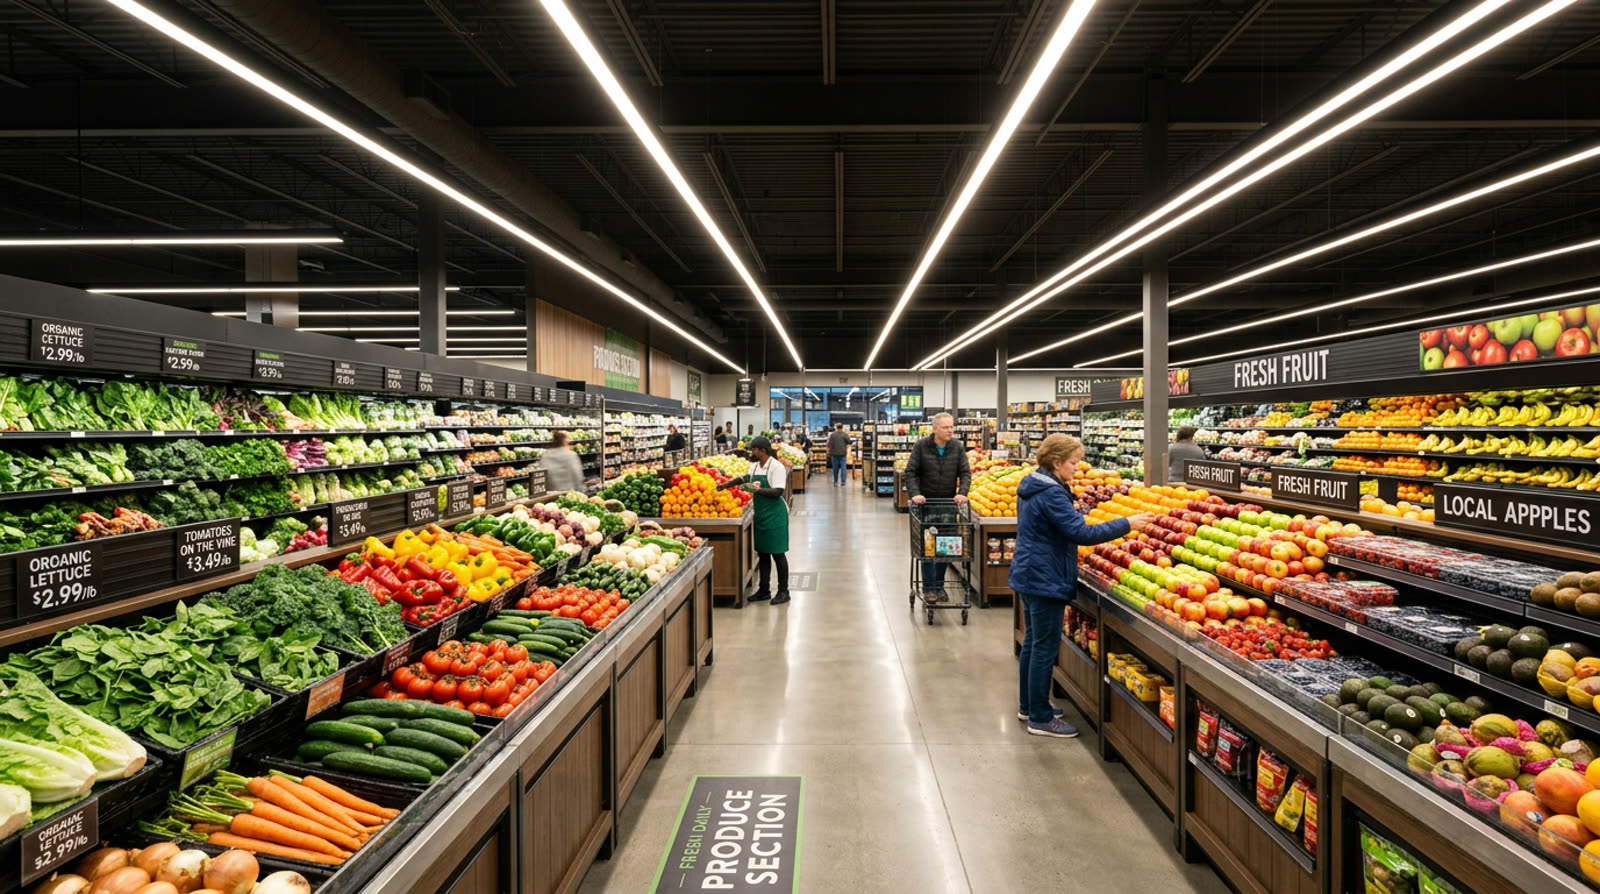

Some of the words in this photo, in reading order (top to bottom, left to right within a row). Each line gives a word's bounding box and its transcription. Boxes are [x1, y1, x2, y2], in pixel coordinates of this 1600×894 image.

[1234, 357, 1277, 388] FRESH
[1282, 349, 1330, 384] FRUIT
[1058, 380, 1091, 393] FRESH
[1278, 475, 1311, 495] FRESH
[1314, 479, 1348, 500] FRUIT
[1443, 494, 1497, 521] LOCAL
[1504, 501, 1591, 534] APPPLES
[180, 544, 195, 556] ON
[196, 540, 215, 553] THE
[216, 535, 236, 549] VINE
[185, 525, 232, 542] TOMATOES
[29, 563, 92, 589] LETTUCE
[32, 582, 97, 609] $2.99/lb
[701, 789, 753, 889] PRODUCE
[745, 794, 788, 884] SECTION
